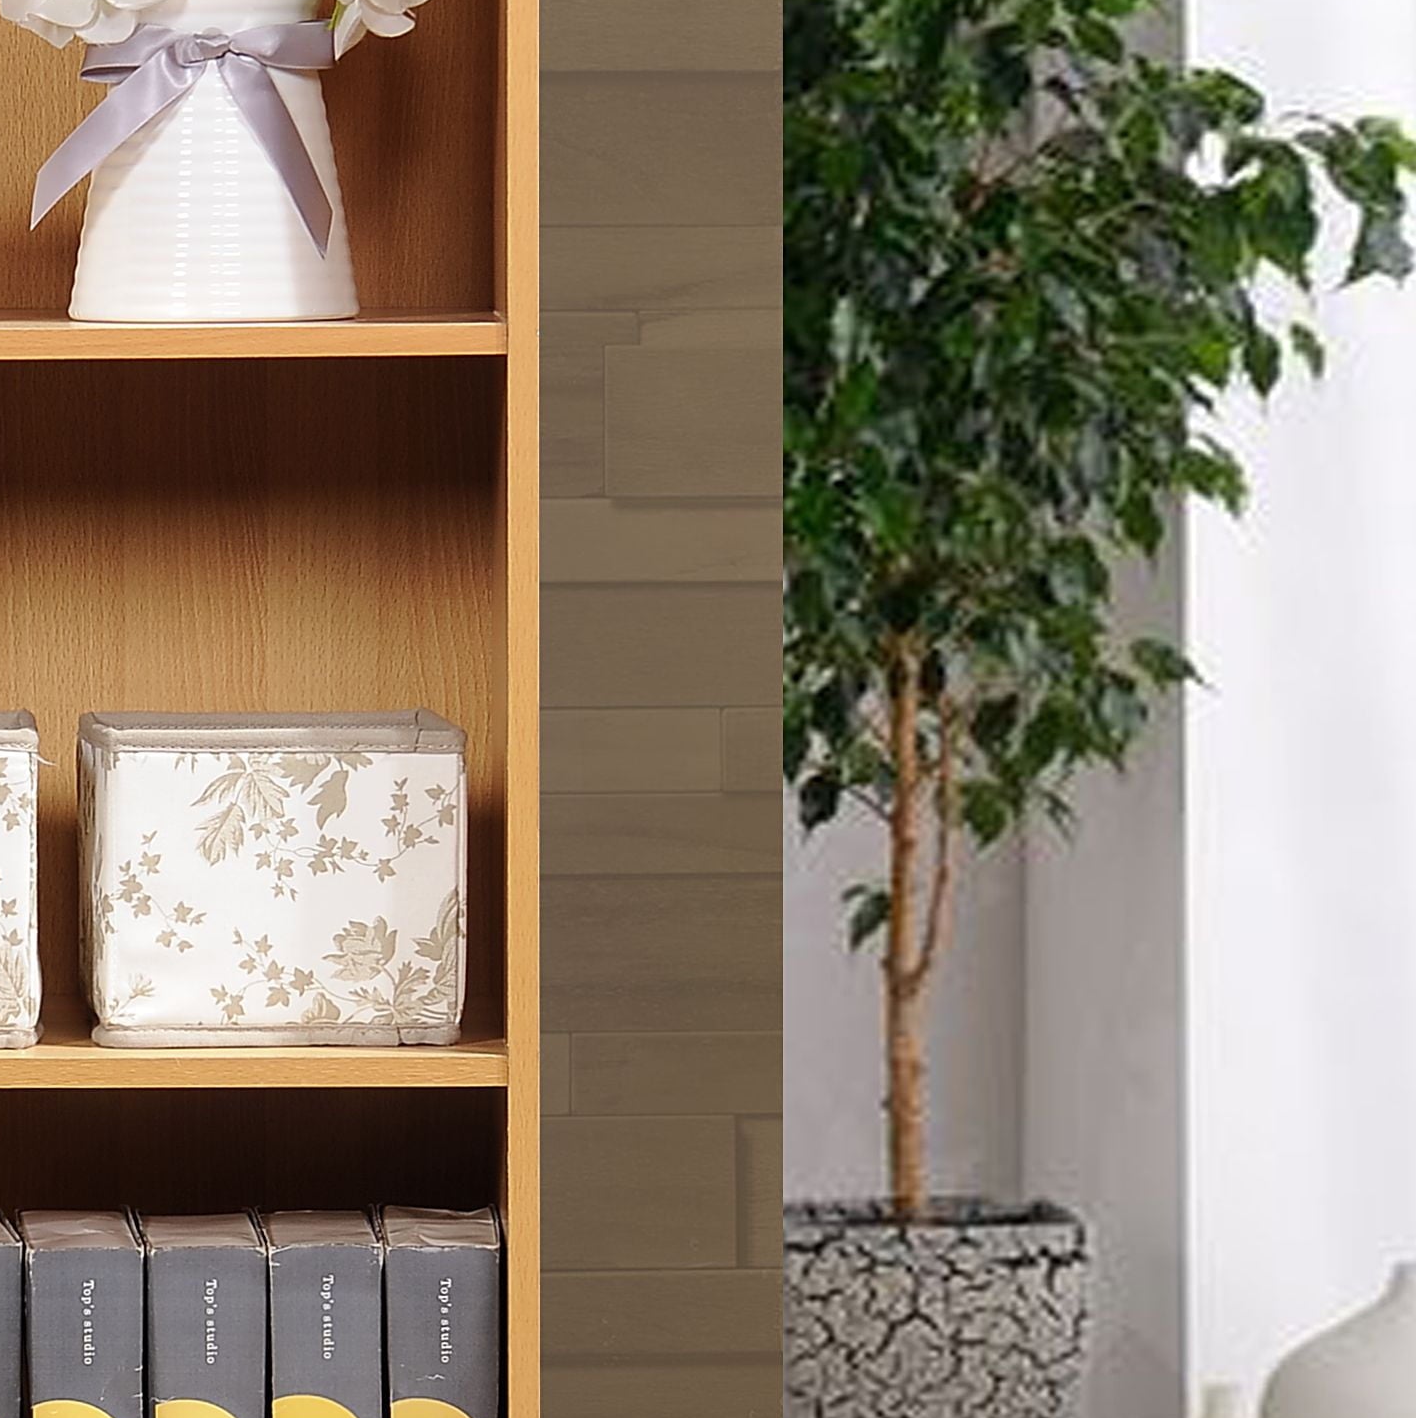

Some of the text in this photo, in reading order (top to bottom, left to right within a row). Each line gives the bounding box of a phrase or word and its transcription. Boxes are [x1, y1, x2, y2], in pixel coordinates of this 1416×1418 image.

[80, 1279, 96, 1365] Top's studio
[203, 1278, 219, 1365] Top's studio
[319, 1274, 335, 1360] Top's studio
[437, 1278, 453, 1364] Top's studio
